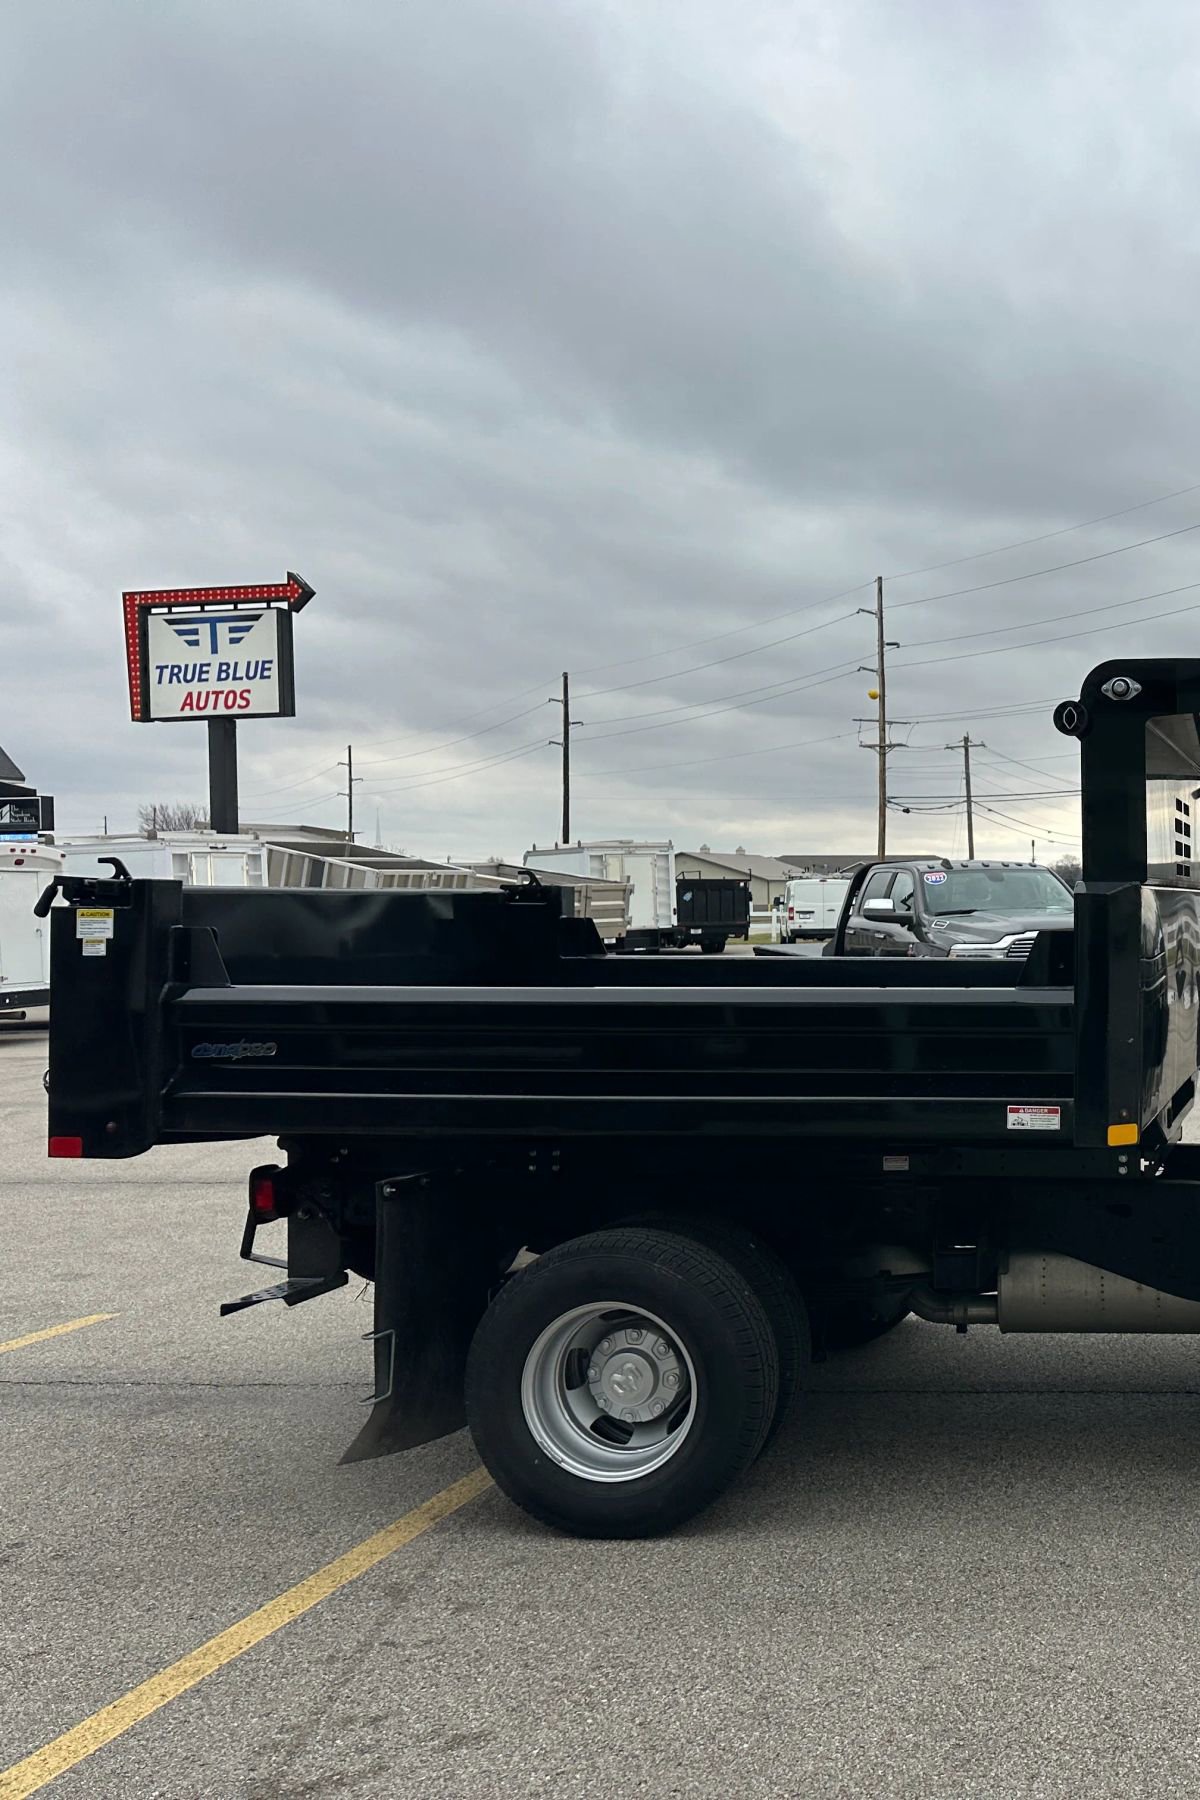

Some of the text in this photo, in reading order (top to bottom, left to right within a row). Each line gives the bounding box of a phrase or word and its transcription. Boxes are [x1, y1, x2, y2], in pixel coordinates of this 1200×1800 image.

[155, 659, 274, 685] TRUE BLUE
[179, 689, 251, 712] AUTOS
